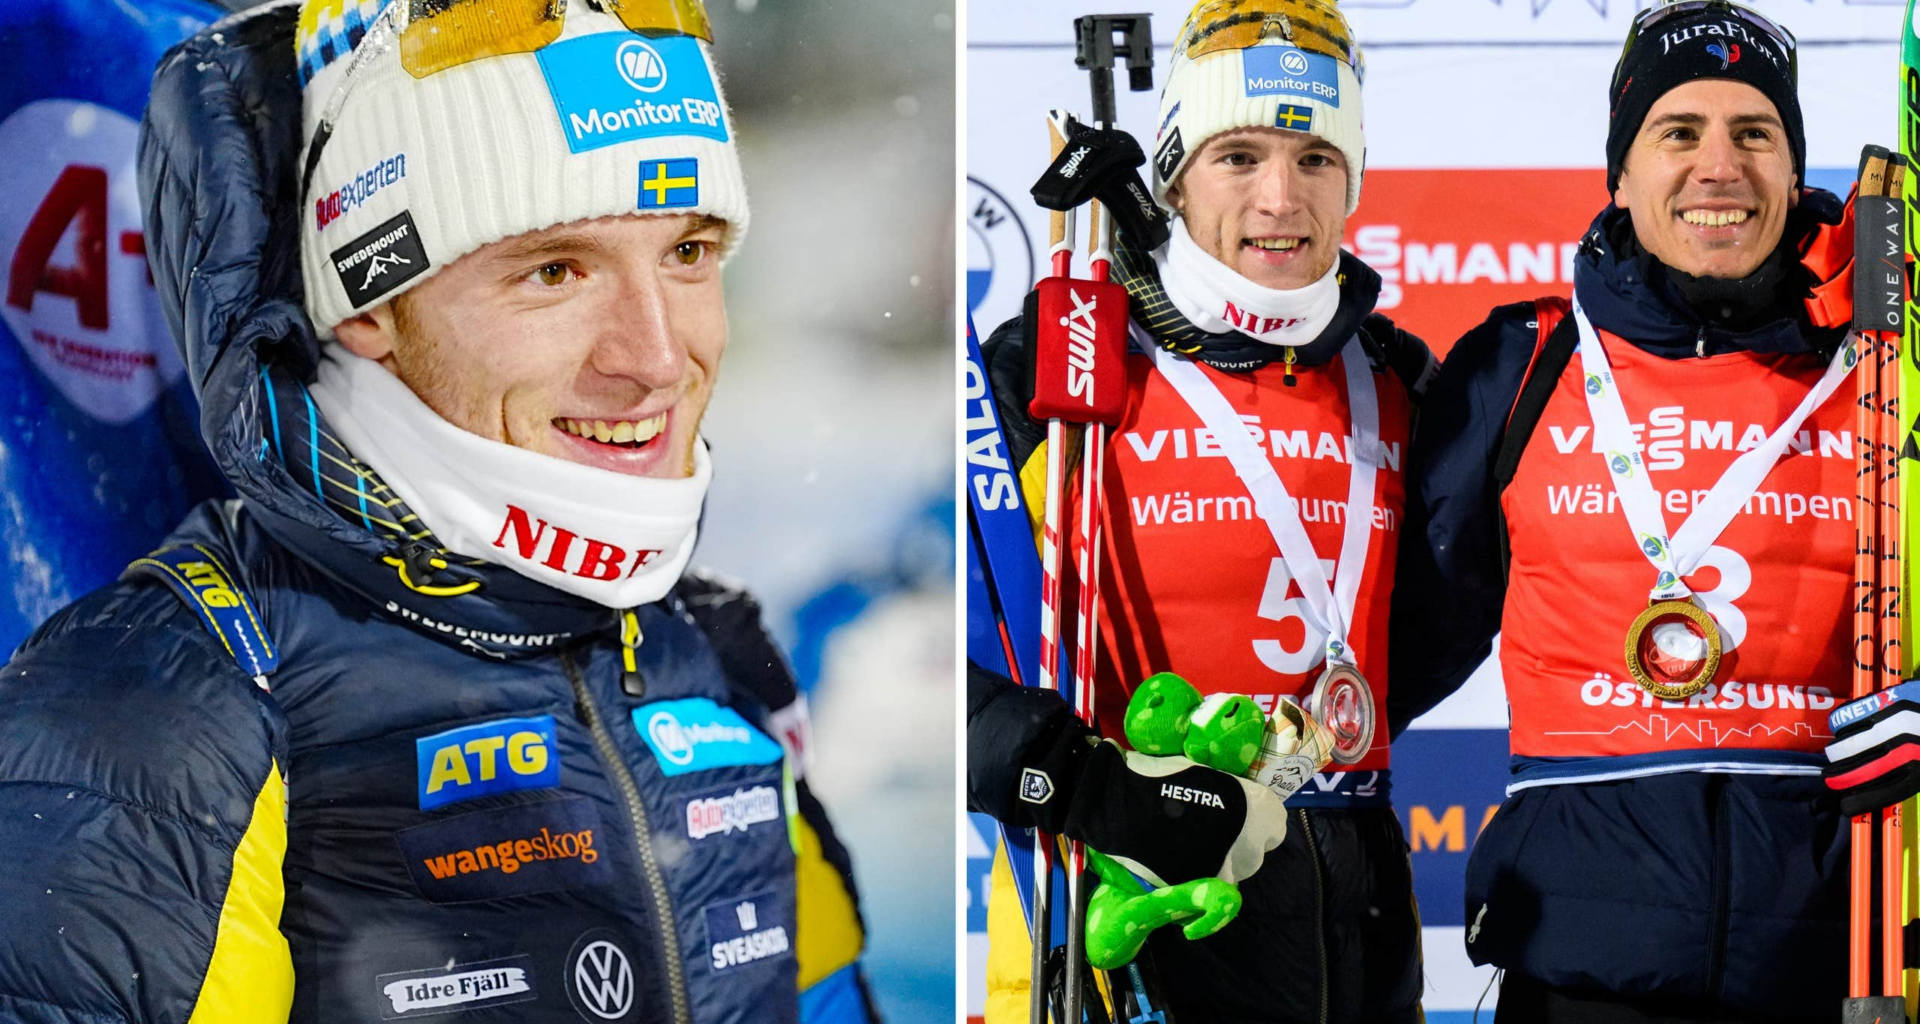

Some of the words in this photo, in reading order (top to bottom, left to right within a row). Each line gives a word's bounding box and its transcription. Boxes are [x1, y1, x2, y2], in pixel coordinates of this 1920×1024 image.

[1248, 76, 1309, 92] Monitor
[1312, 81, 1337, 99] ERP
[570, 98, 682, 139] Monitor
[682, 98, 720, 128] ERP
[316, 153, 406, 232] Autoexperten
[337, 224, 409, 273] SWEDEMOUNT
[177, 562, 239, 608] ATG
[1251, 557, 1336, 675] 5
[426, 731, 548, 795] ATG
[1160, 783, 1225, 810] HESTRA
[424, 827, 599, 881] wangeskog
[405, 983, 455, 1002] Idre
[458, 971, 509, 998] Fjäll
